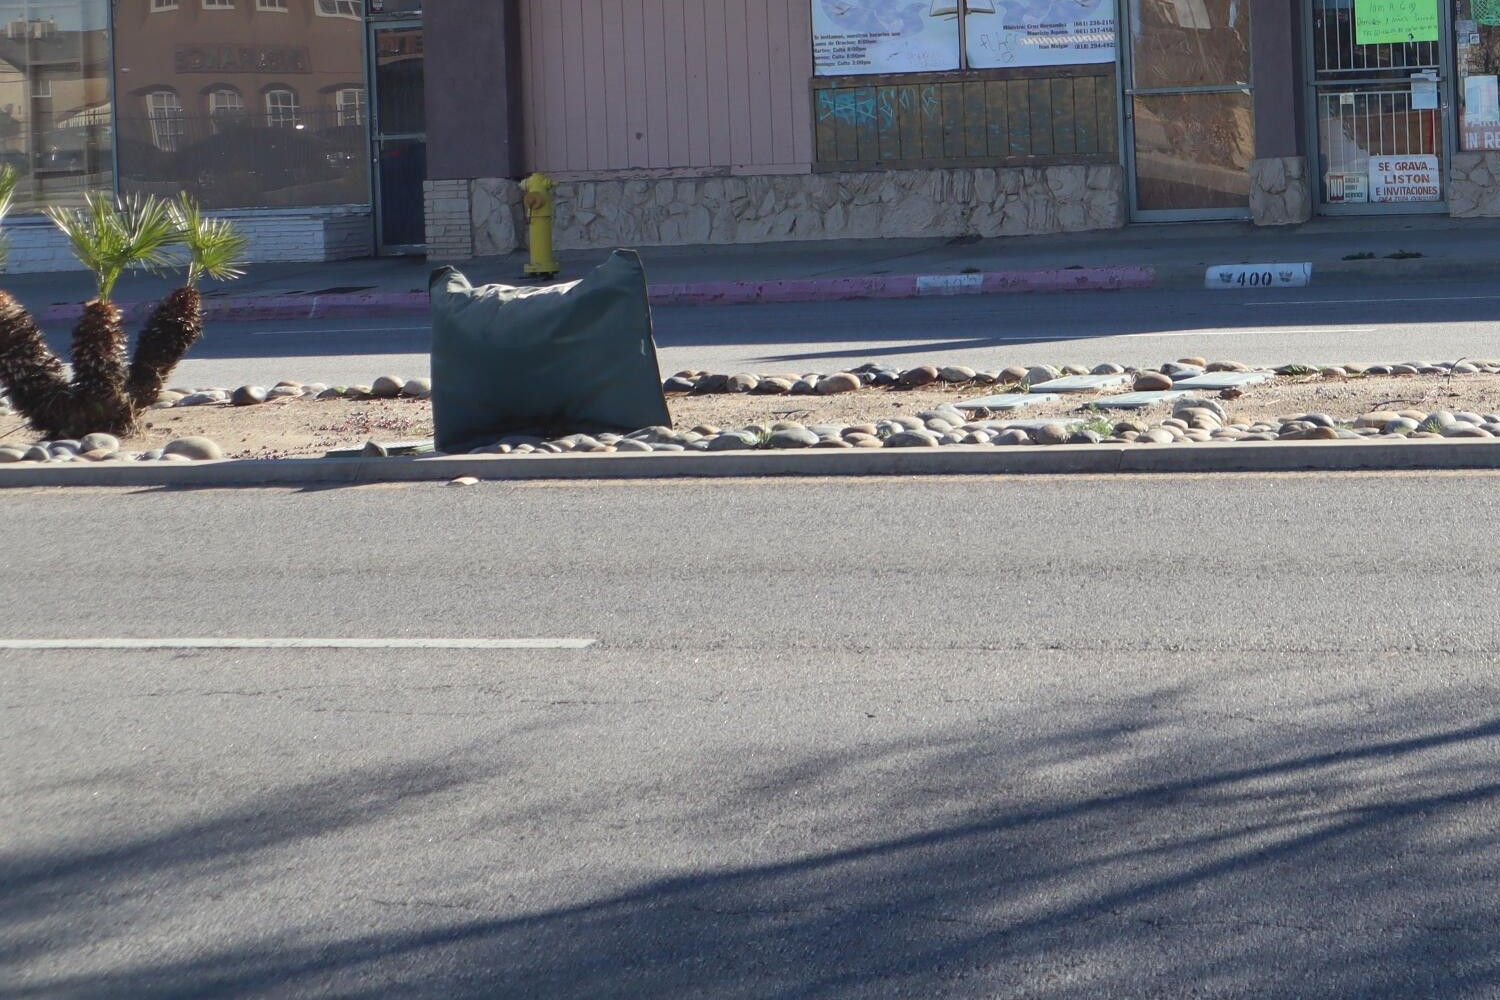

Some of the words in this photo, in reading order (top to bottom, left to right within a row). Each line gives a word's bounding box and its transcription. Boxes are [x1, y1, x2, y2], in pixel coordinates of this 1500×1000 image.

[1465, 132, 1478, 149] IN
[1378, 162, 1390, 171] SE
[1384, 174, 1430, 185] LISTON
[1330, 178, 1343, 197] NO
[1375, 188, 1381, 196] E
[1383, 186, 1439, 196] INVITACIONES
[1236, 271, 1273, 286] 400
